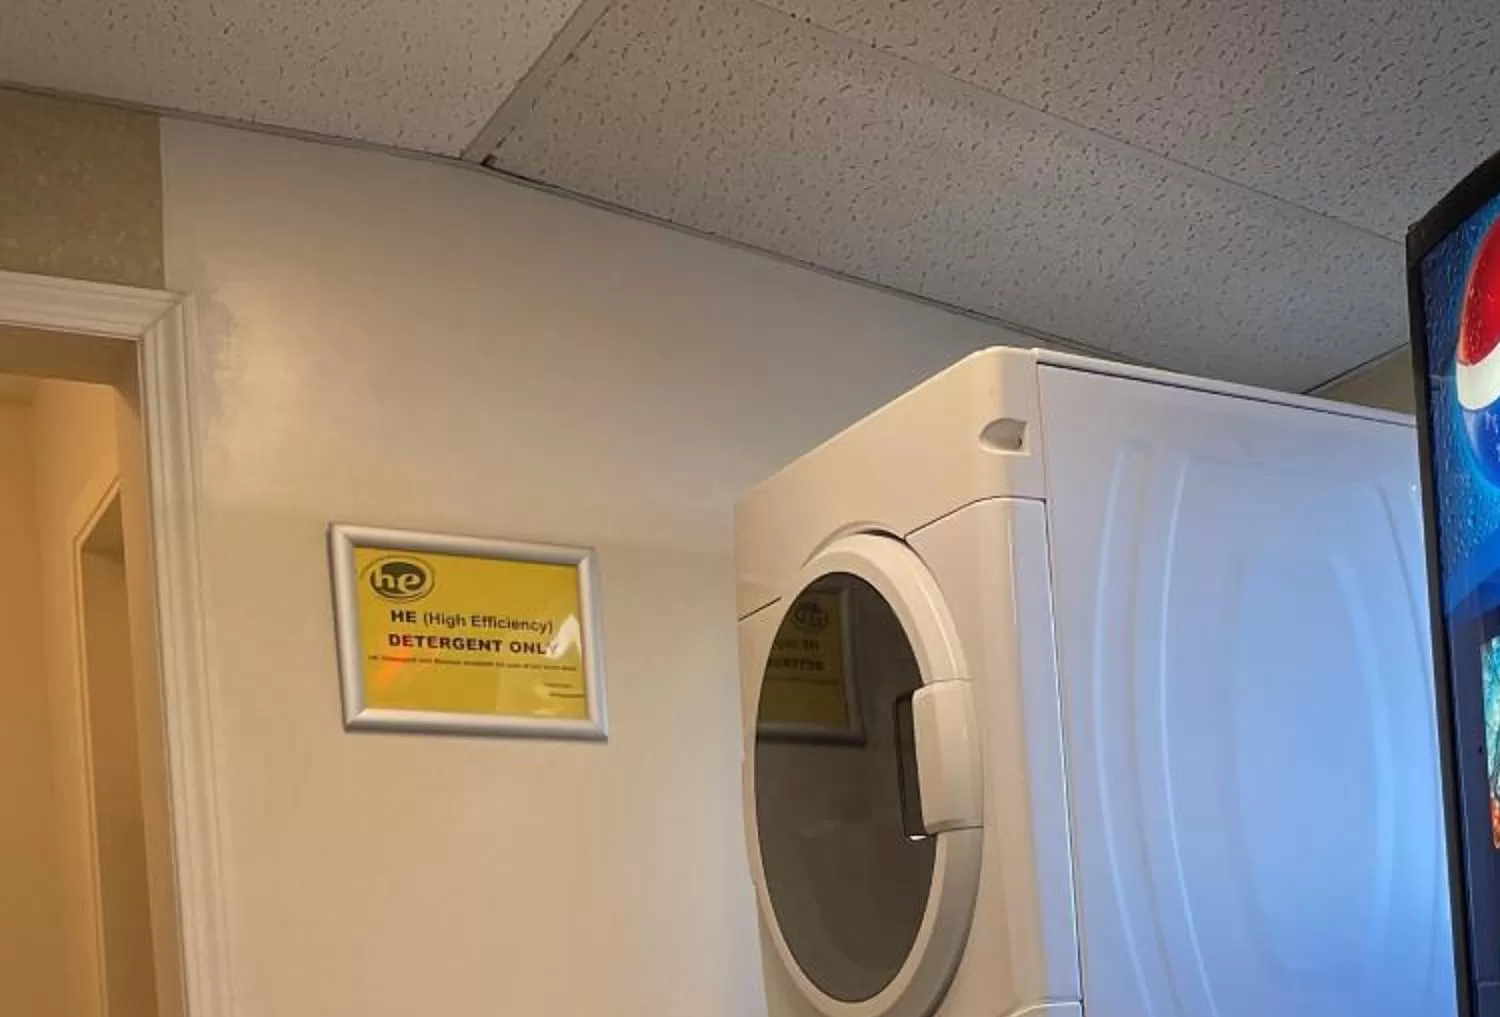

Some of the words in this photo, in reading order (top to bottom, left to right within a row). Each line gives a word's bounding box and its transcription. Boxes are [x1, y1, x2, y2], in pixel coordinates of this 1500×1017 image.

[391, 609, 417, 624] HE
[423, 612, 467, 630] (High
[471, 614, 553, 635] Efficiency)
[388, 633, 502, 653] DETERGENT
